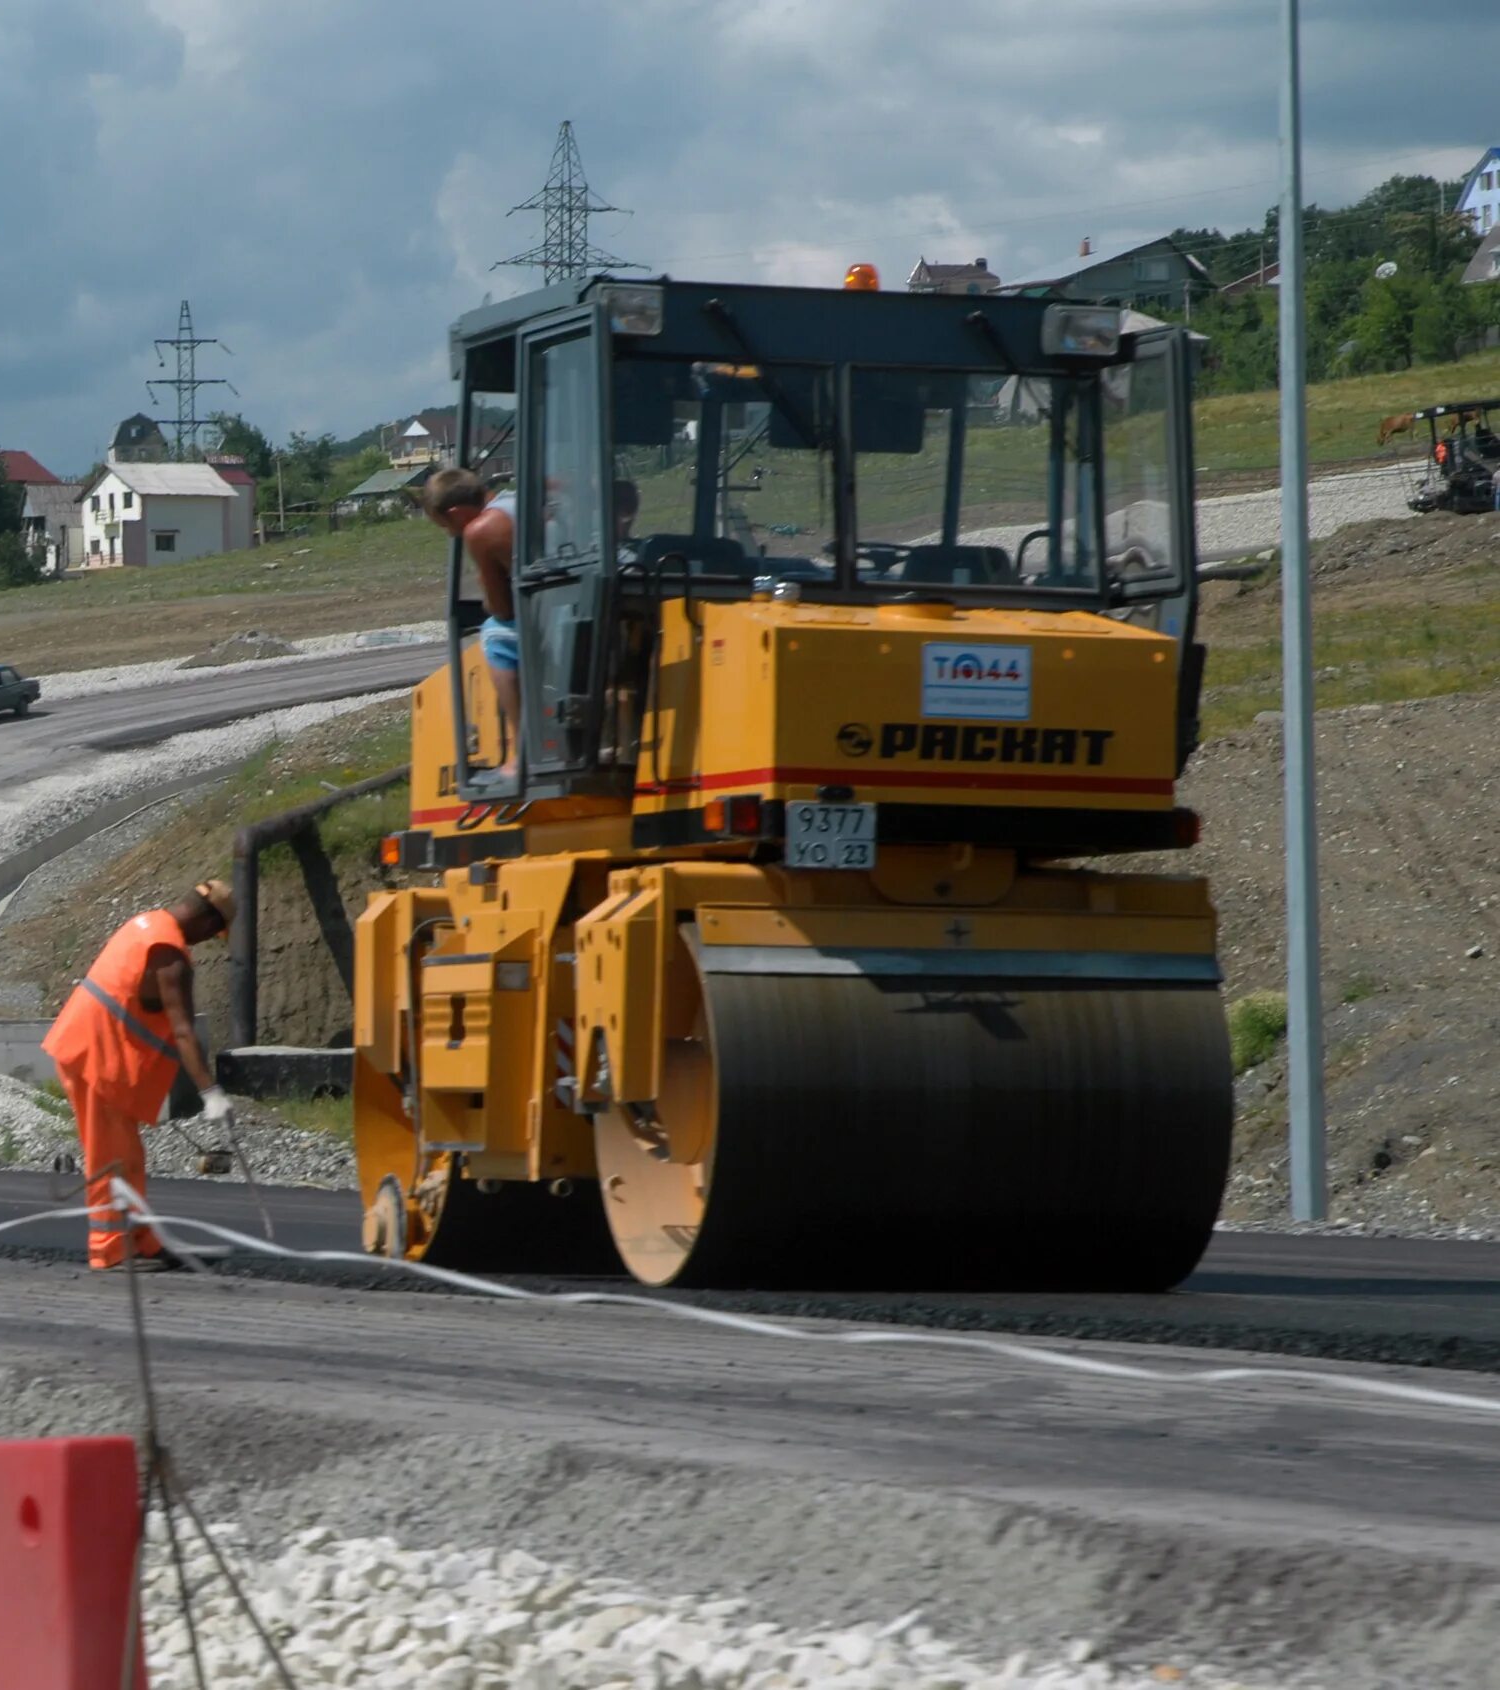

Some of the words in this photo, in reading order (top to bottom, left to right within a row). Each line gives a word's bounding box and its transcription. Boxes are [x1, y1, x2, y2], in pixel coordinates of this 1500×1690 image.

[879, 723, 1115, 766] РАСКАТ
[798, 806, 865, 834] 9377
[843, 844, 868, 865] 23
